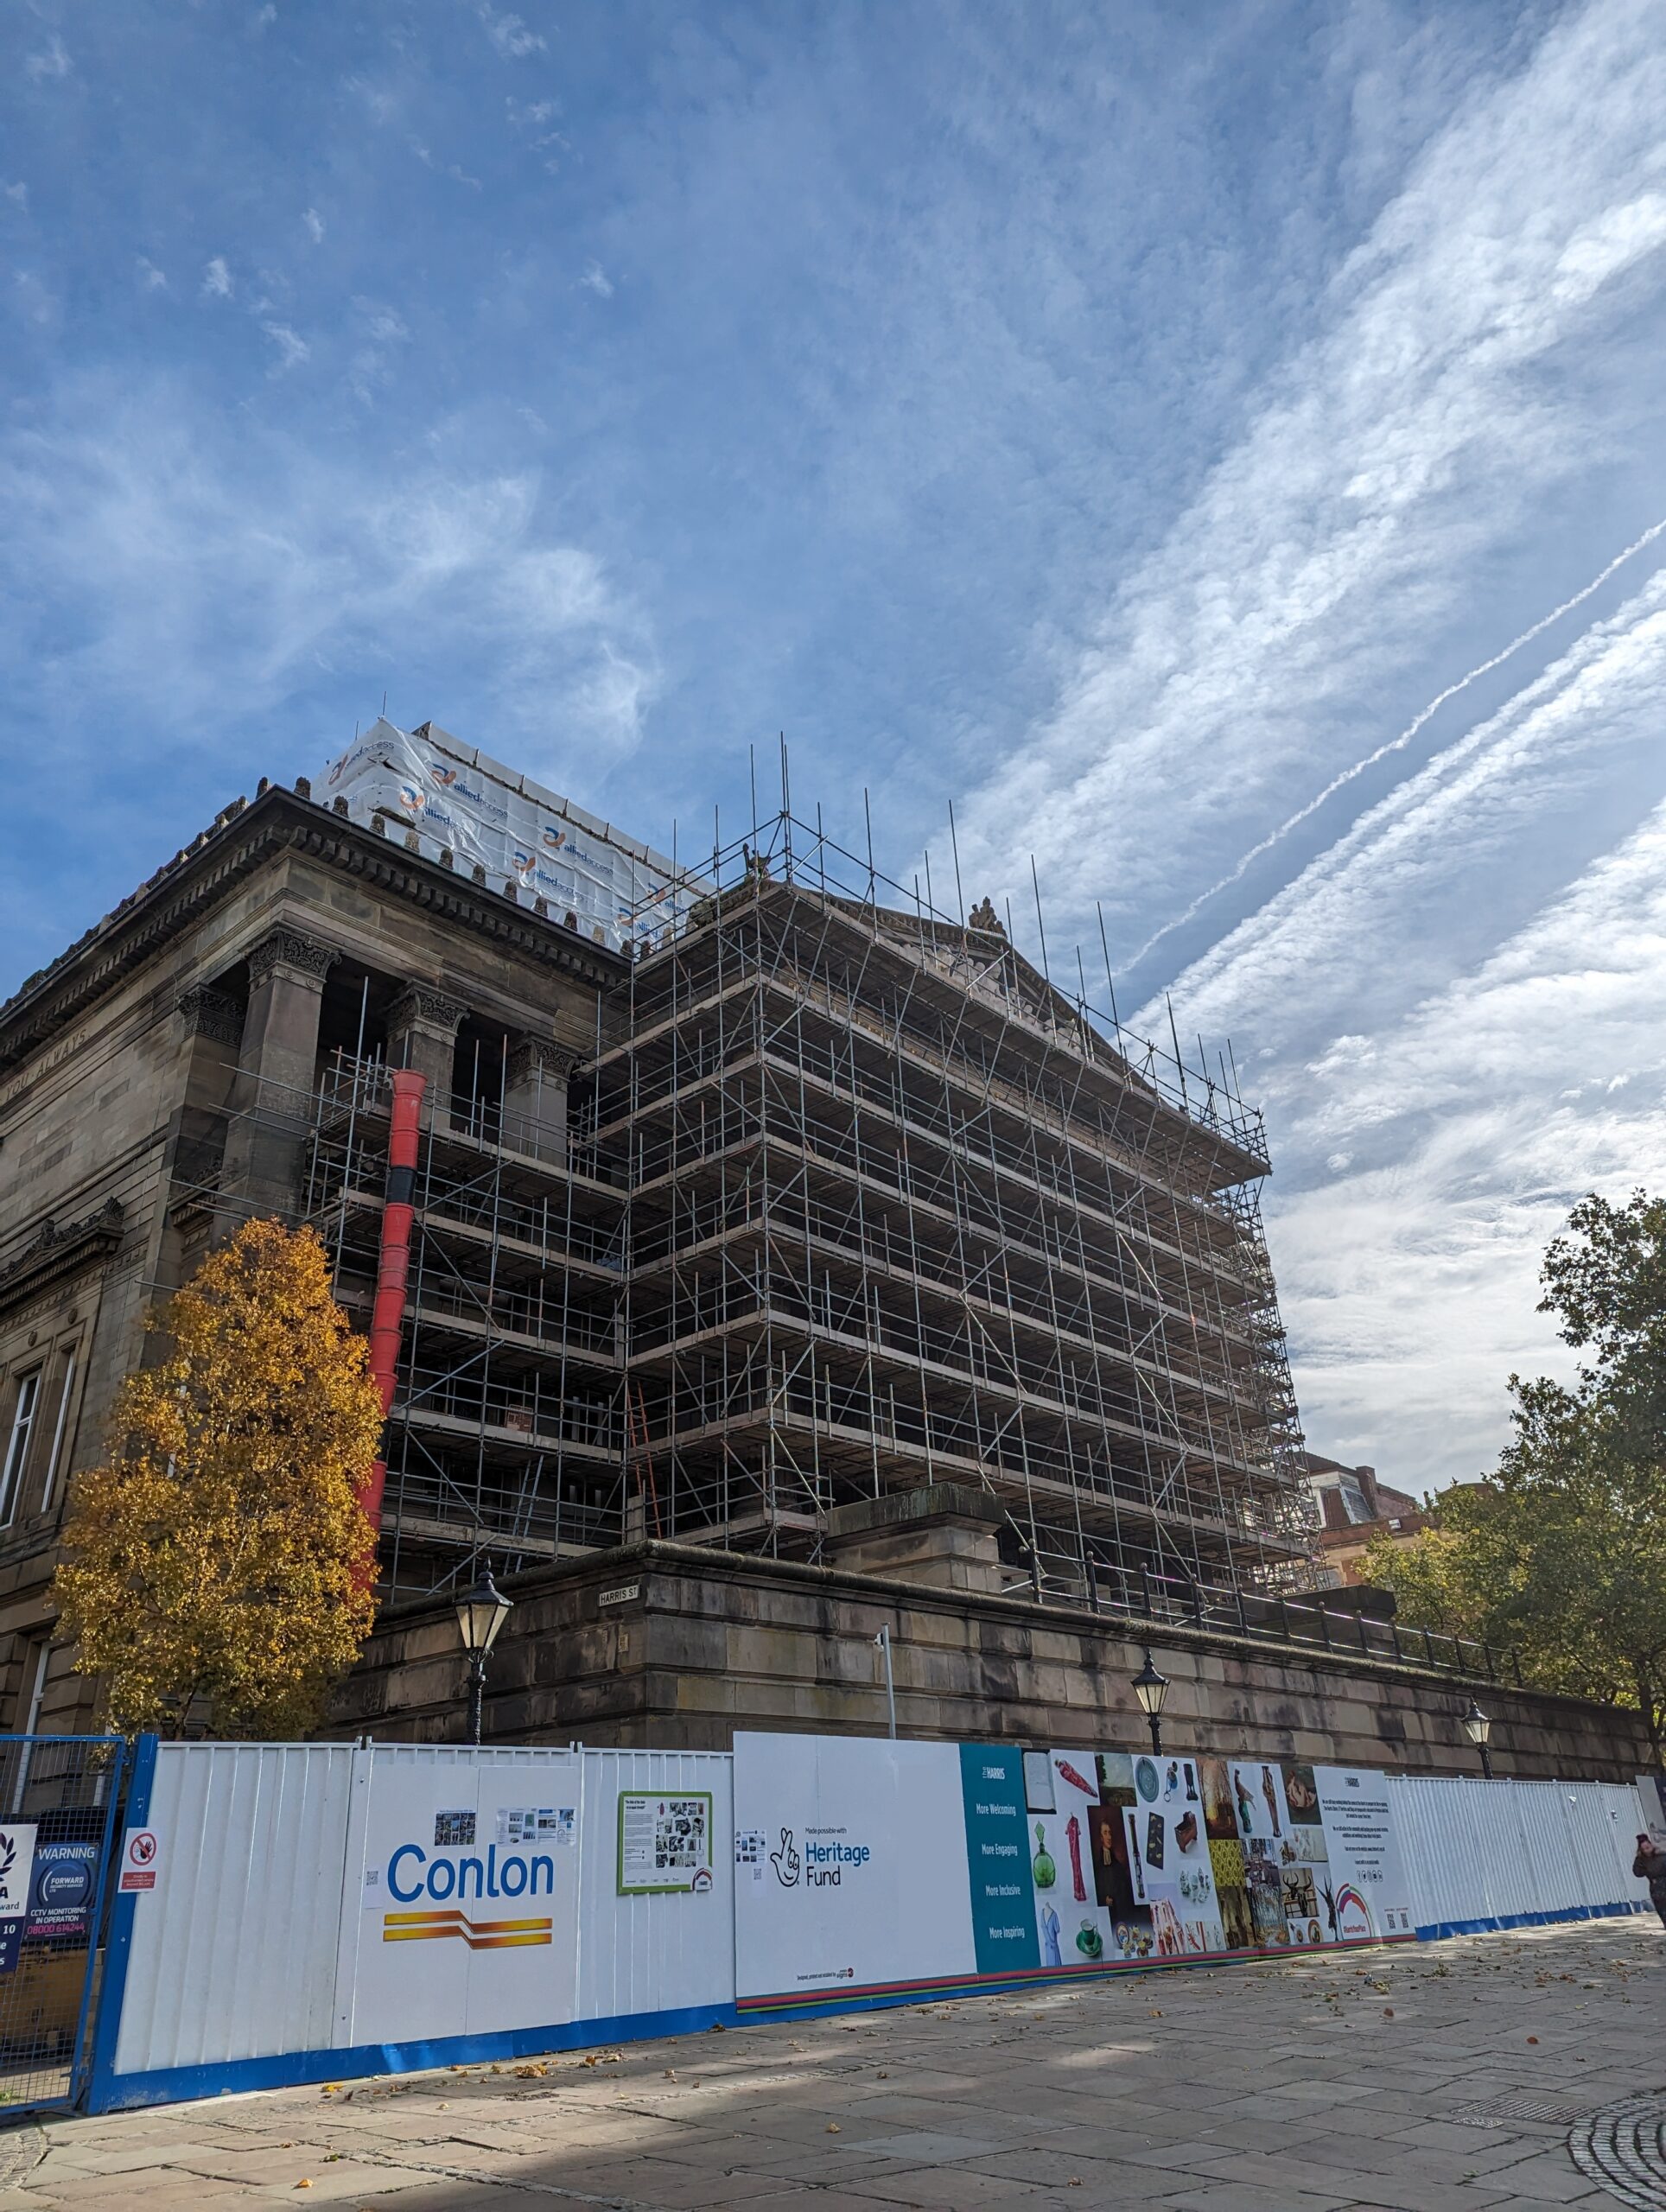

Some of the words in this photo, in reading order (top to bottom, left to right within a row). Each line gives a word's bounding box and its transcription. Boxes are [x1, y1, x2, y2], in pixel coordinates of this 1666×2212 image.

[601, 1590, 626, 1605] HARRIS
[987, 1766, 1005, 1780] HARRIS
[976, 1803, 989, 1815] More
[989, 1804, 1016, 1817] Welcoming
[817, 1827, 836, 1836] possible
[38, 1847, 95, 1860] WARNING
[805, 1841, 870, 1867] Heritage
[982, 1843, 995, 1855] More
[995, 1843, 1018, 1857] Engaging
[387, 1843, 554, 1903] Conlon
[806, 1865, 842, 1886] Fund
[51, 1876, 85, 1885] FORWARD
[985, 1885, 999, 1897] More
[999, 1884, 1021, 1897] Inclusive
[47, 1906, 86, 1916] MONITORING
[43, 1915, 79, 1924] OPERATION
[3, 1924, 16, 1935] 10
[27, 1925, 54, 1935] 08000
[56, 1923, 85, 1933] 614244
[989, 1927, 1003, 1939] More
[1003, 1925, 1025, 1940] Inspiring
